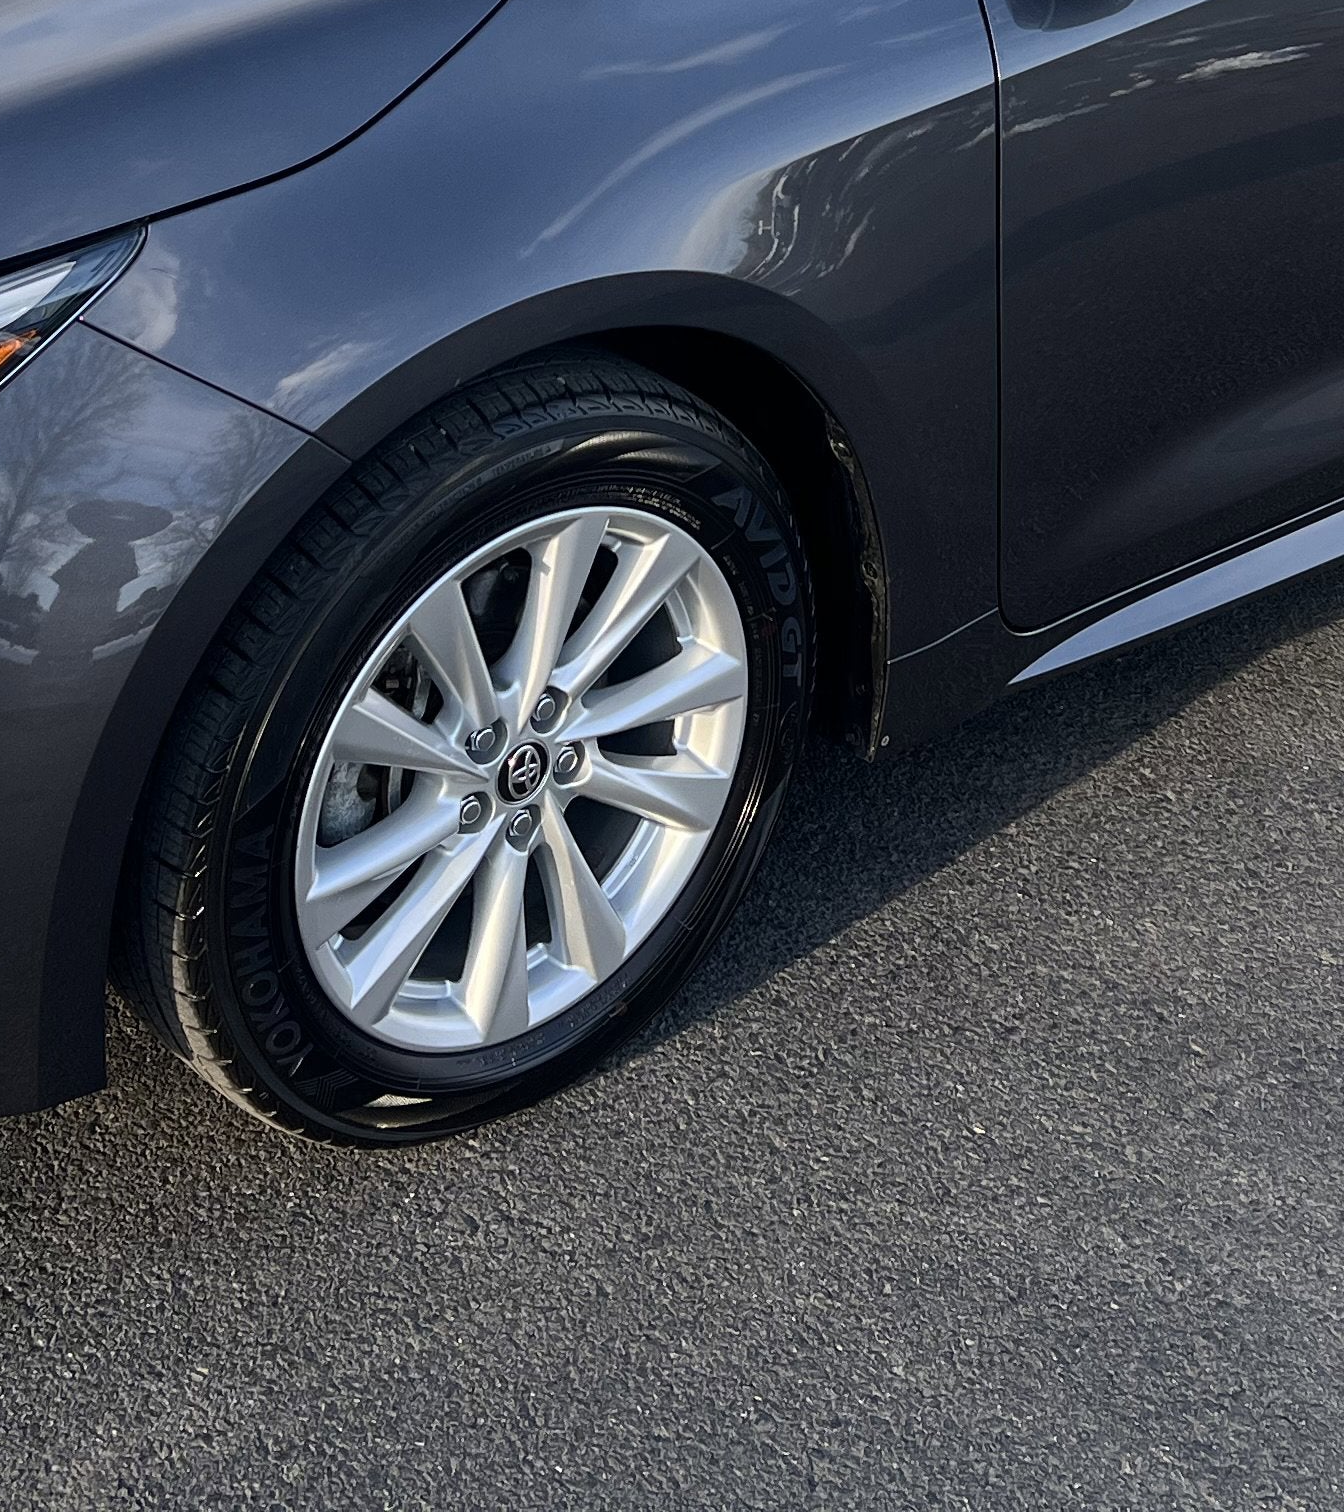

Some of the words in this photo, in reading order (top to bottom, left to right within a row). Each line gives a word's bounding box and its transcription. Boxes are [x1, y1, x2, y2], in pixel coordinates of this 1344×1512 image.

[711, 487, 798, 606] AVID
[781, 616, 802, 688] GT
[230, 824, 314, 1077] YOKOHAMA
